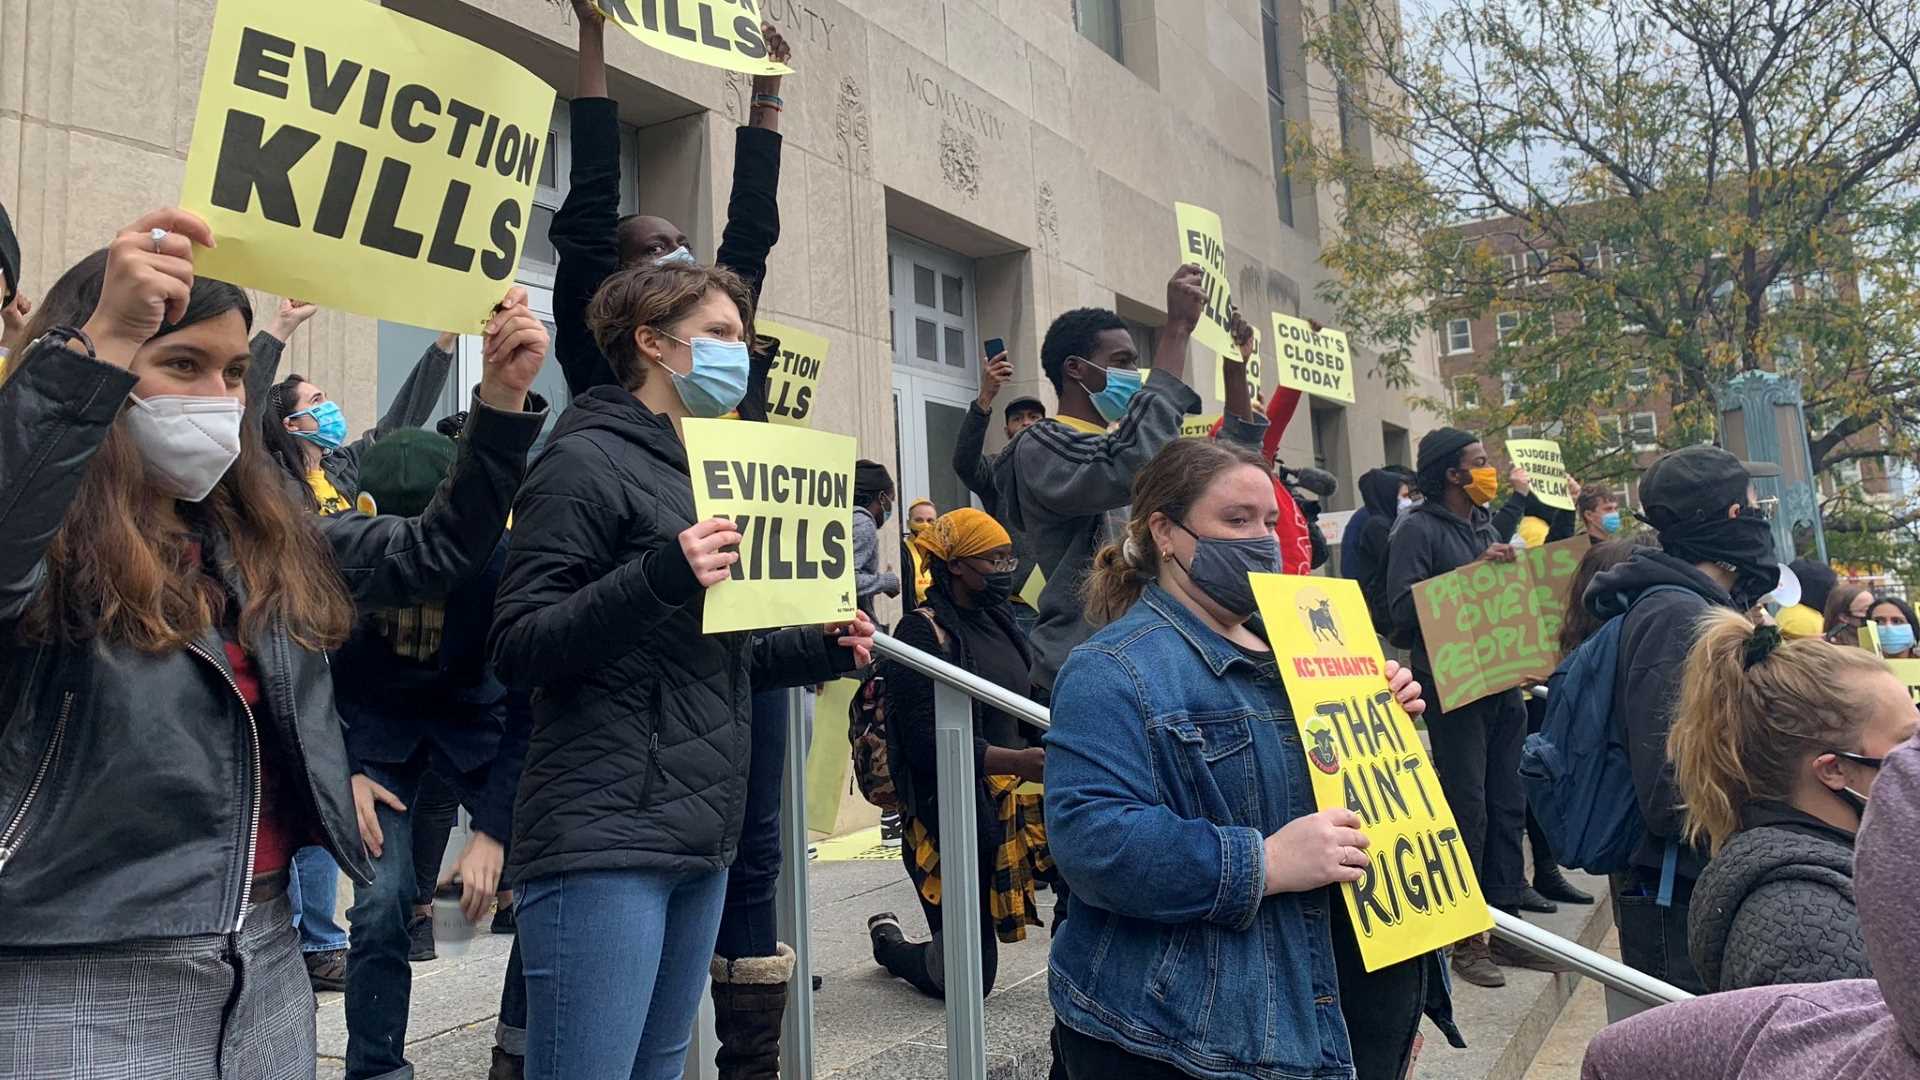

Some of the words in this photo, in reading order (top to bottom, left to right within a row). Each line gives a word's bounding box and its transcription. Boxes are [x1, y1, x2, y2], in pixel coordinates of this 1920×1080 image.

[760, 0, 834, 52] UNTY
[233, 26, 539, 187] EVICTION
[904, 66, 1006, 141] MCMXXXIV
[211, 107, 523, 281] KILLS
[1191, 261, 1233, 333] ILLS
[1278, 323, 1345, 353] COURT'S
[1284, 344, 1345, 371] CLOSED
[1290, 364, 1341, 390] TODAY
[702, 460, 848, 509] EVICTION
[1424, 547, 1578, 620] PROFITS
[1455, 582, 1562, 632] OVER
[1292, 656, 1316, 678] KC
[1312, 656, 1379, 677] TENANTS
[1434, 613, 1563, 686] PEOPLE
[1315, 689, 1408, 761] THAT
[1341, 753, 1438, 829] AIN'T
[1350, 826, 1471, 938] RIGHT
